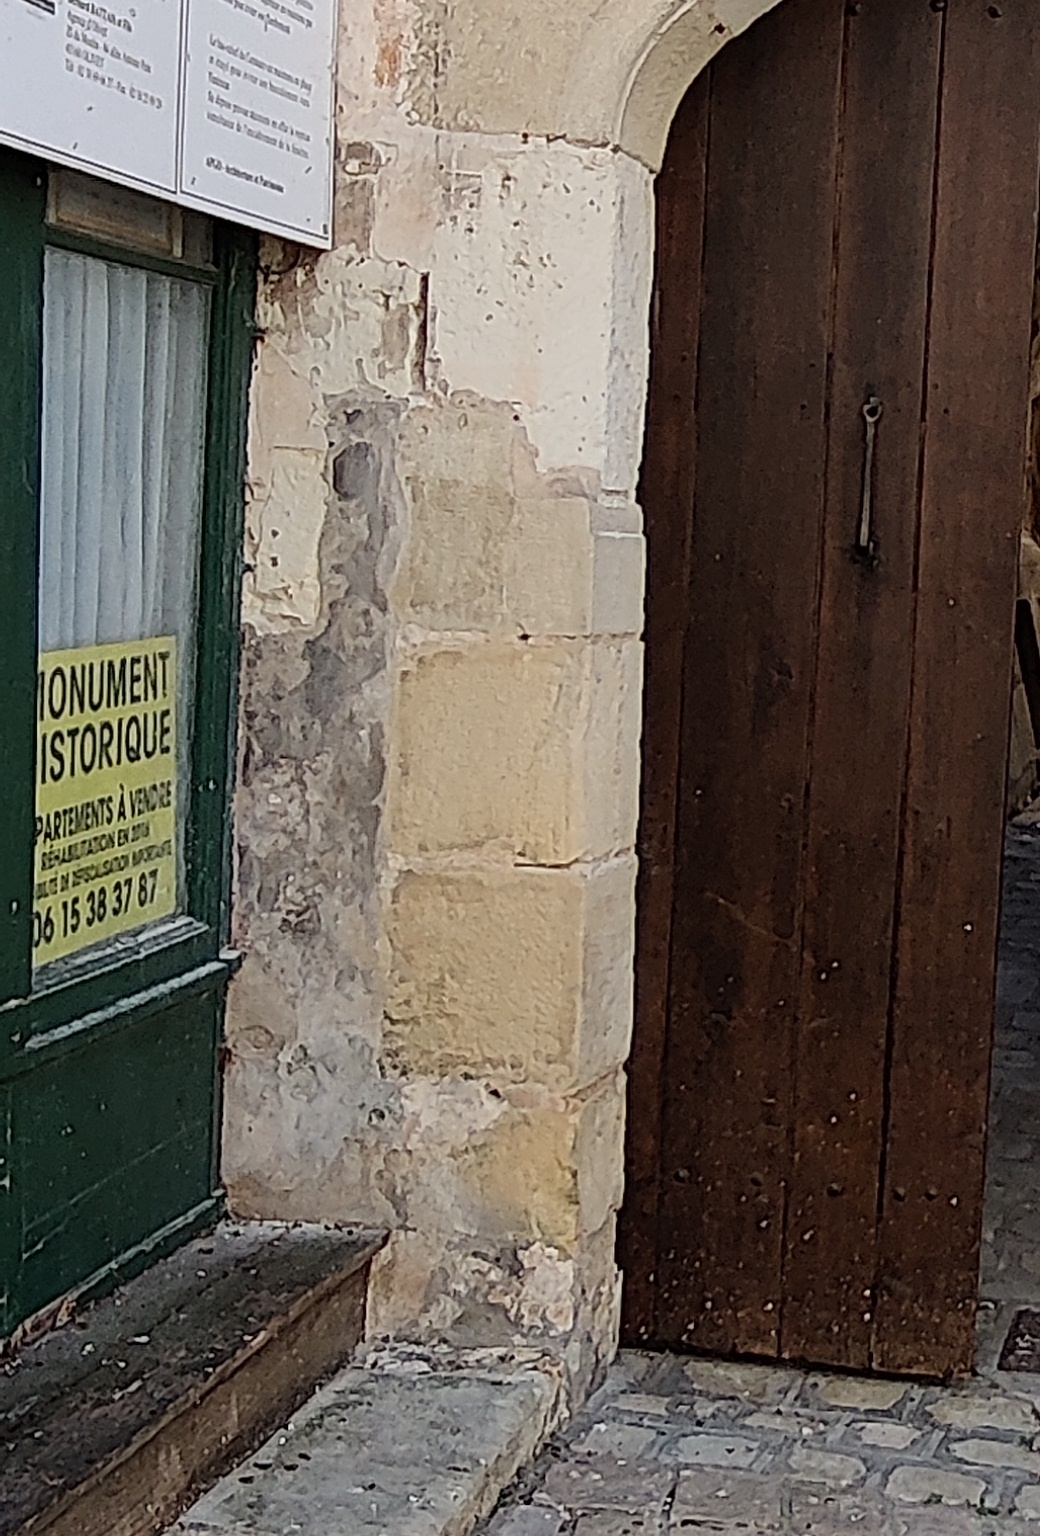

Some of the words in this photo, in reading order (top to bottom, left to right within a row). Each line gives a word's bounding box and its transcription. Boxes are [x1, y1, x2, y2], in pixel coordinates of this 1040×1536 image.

[39, 651, 170, 722] ONUMENT
[41, 709, 170, 784] ISTORIQUE
[117, 783, 127, 822] À
[129, 780, 172, 818] VENDRE
[117, 828, 129, 847] EN
[34, 906, 54, 948] 06
[62, 896, 80, 938] 15
[86, 886, 107, 927] 38
[112, 876, 133, 916] 37
[138, 868, 159, 908] 87
